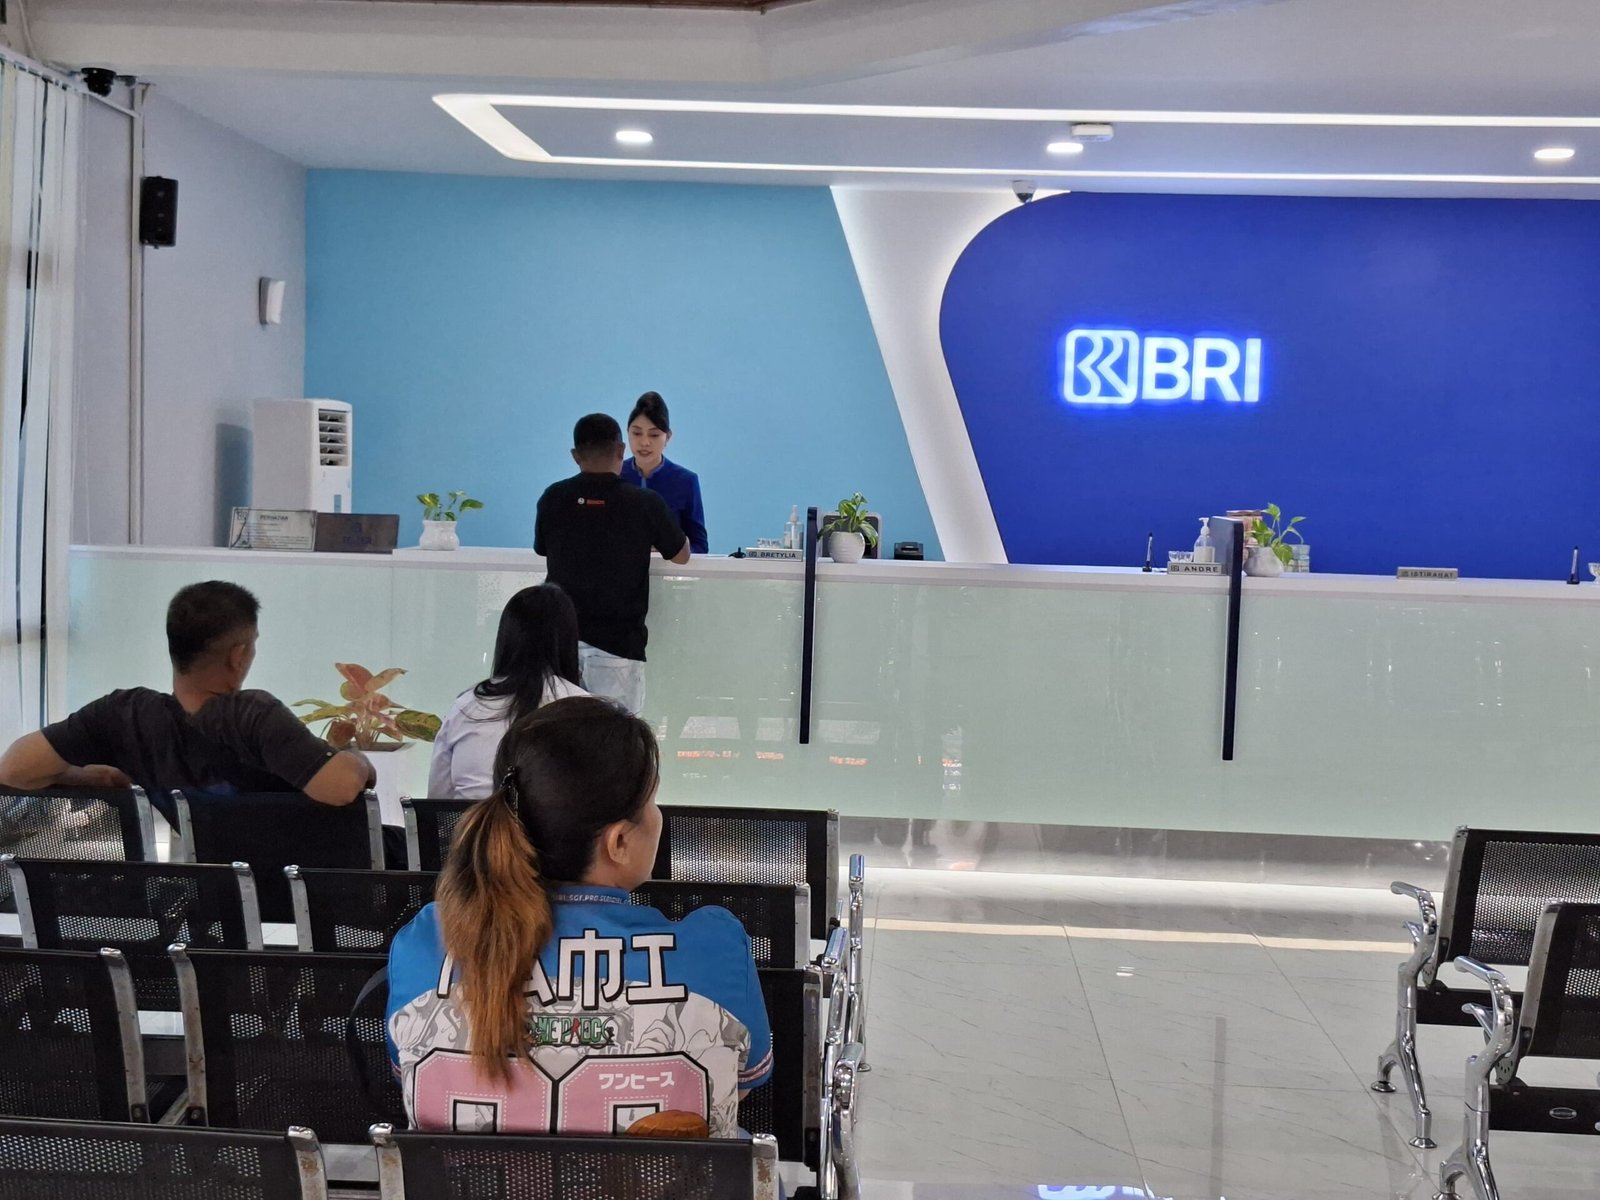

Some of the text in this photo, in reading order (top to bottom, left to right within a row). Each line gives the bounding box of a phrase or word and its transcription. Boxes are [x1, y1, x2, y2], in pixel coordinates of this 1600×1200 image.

[1142, 336, 1262, 402] BRI
[760, 551, 796, 559] BRETYLIA
[1184, 565, 1219, 573] ANDRE
